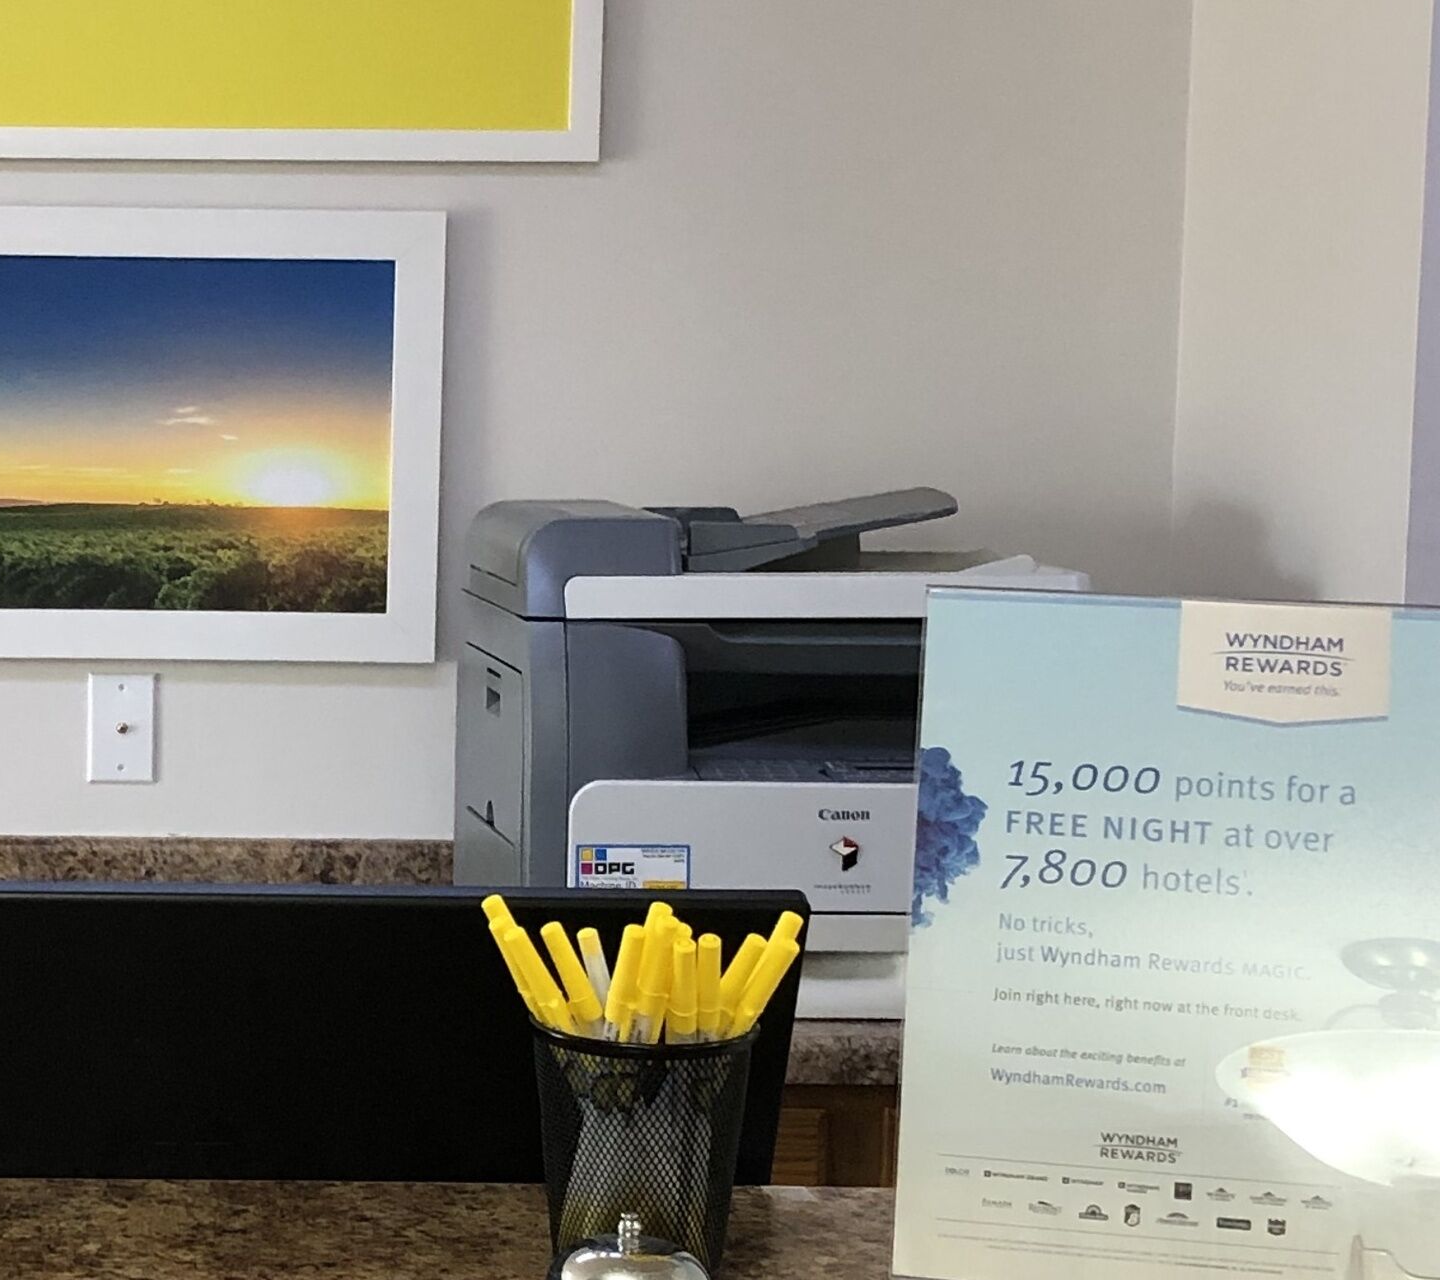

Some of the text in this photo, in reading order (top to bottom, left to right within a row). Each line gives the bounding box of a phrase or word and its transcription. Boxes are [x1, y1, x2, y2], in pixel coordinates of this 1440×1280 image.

[1225, 631, 1345, 653] WYNDHAM
[1224, 655, 1344, 677] REWARDS
[1223, 679, 1266, 695] You've
[1267, 683, 1310, 697] earned
[1007, 759, 1357, 805] 15,000 points for a
[818, 808, 871, 821] Canon
[1005, 810, 1334, 852] FREE NIGHT at over
[998, 849, 1129, 890] 7,800
[999, 912, 1094, 938] No tricks,
[996, 943, 1312, 981] just Wyndham Rewards MAGIC.
[993, 987, 1022, 1003] Join
[1025, 988, 1059, 1008] right
[1063, 991, 1100, 1009] here,
[1104, 995, 1138, 1014] right
[1142, 999, 1173, 1013] now
[1177, 1001, 1192, 1014] at
[1195, 1001, 1220, 1017] the
[1222, 1003, 1259, 1020] front
[991, 1043, 1186, 1067] Learn about the exciting benefits at
[990, 1067, 1167, 1095] WyndhamRewards.com
[1100, 1131, 1179, 1148] WYNDHAM
[1099, 1147, 1178, 1164] REWARDS
